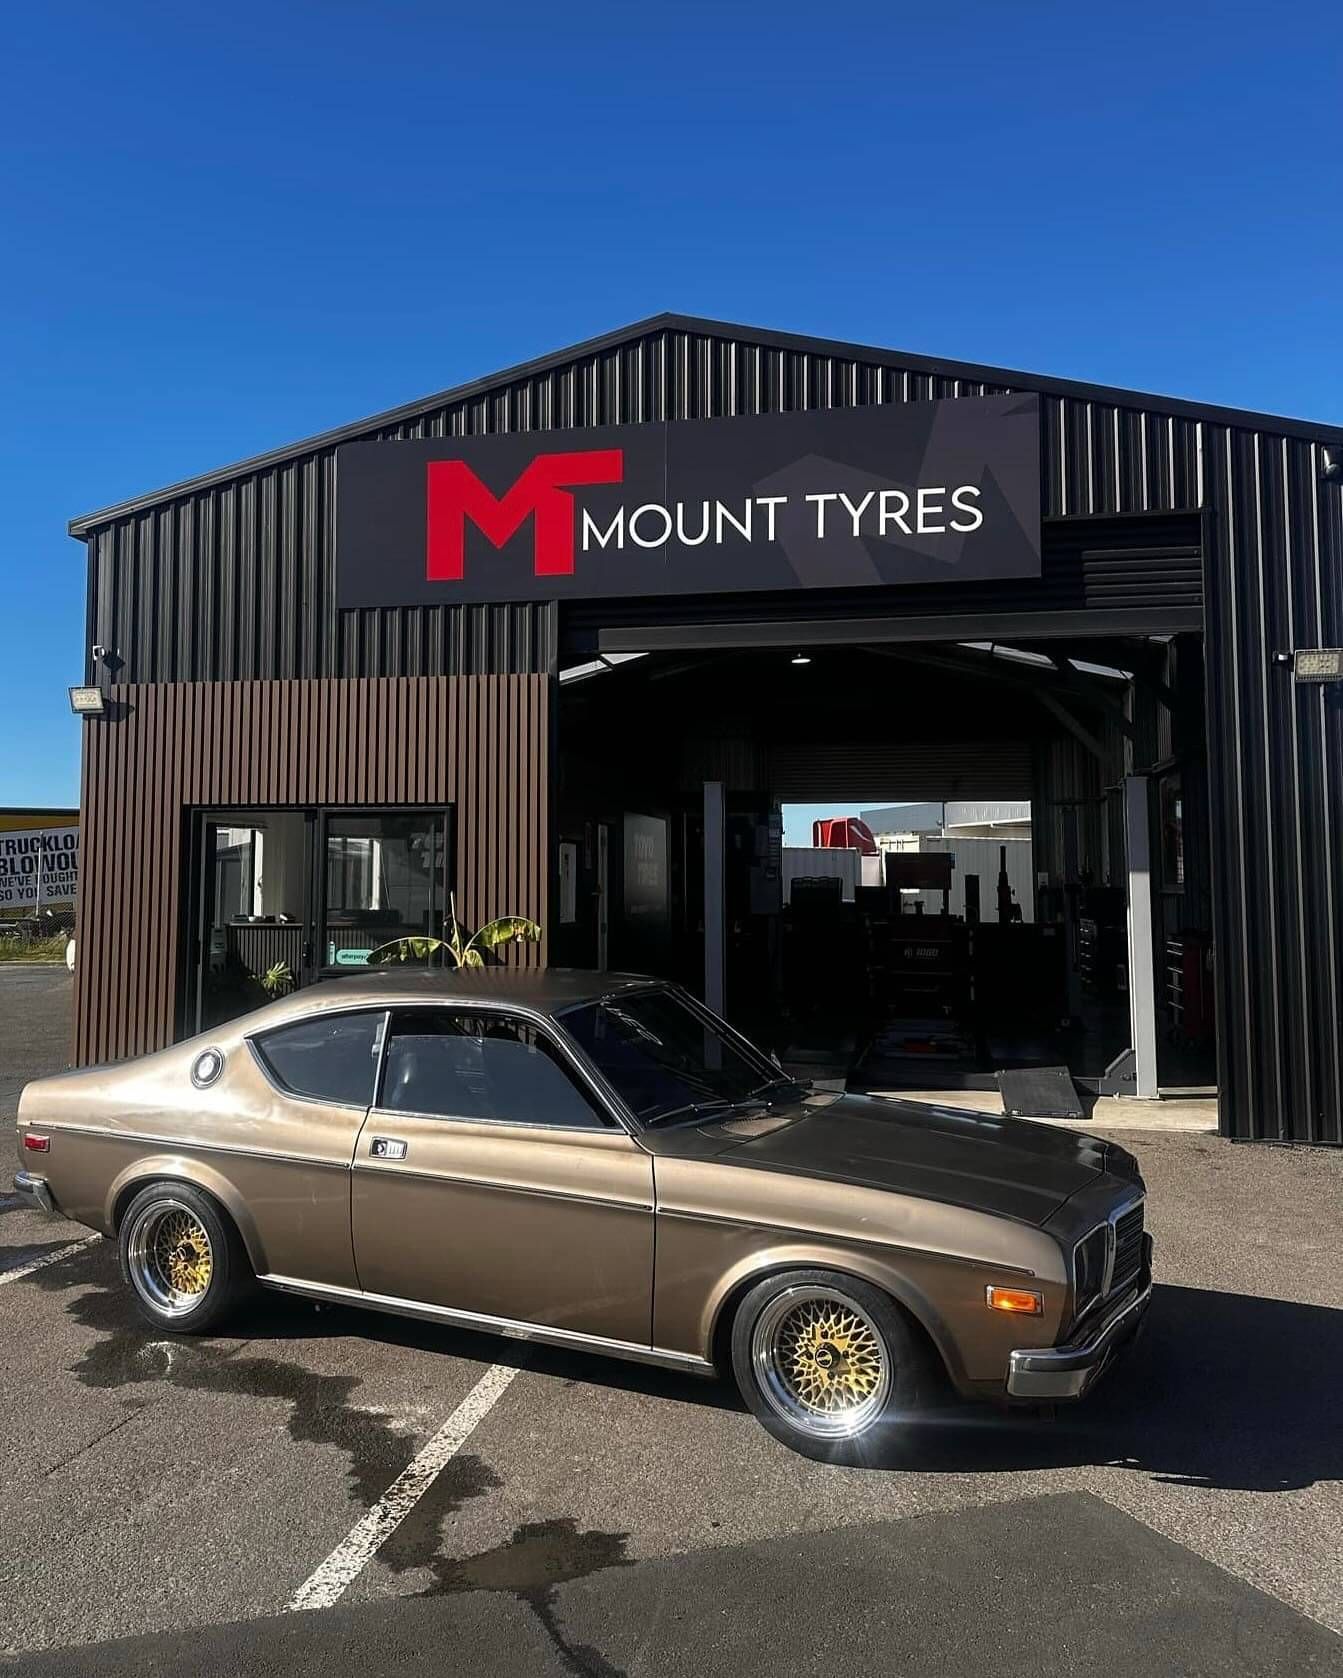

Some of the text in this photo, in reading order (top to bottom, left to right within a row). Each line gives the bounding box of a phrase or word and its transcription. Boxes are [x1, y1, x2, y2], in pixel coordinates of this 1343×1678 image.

[582, 485, 983, 551] MOUNT TYRES
[0, 833, 79, 856] RUCKLO
[46, 884, 77, 897] SAVE
